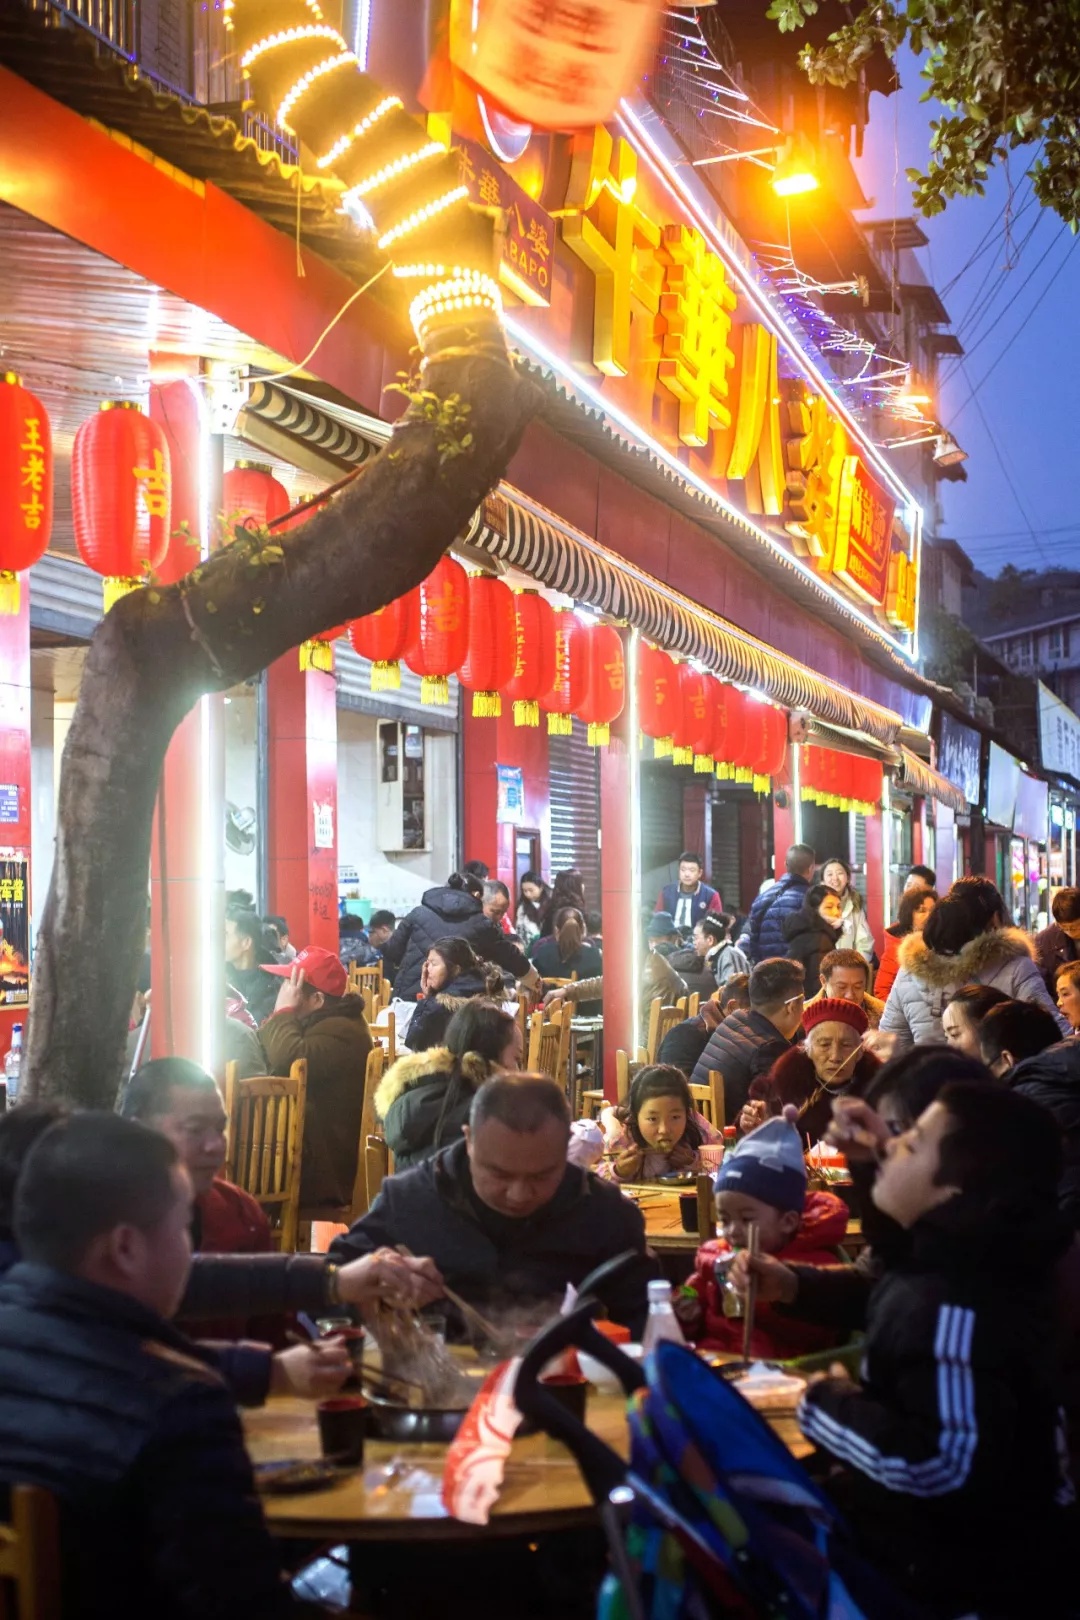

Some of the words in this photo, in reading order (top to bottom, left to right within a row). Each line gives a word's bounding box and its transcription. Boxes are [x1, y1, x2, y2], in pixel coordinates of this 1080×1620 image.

[20, 418, 46, 529] 王老吉
[132, 448, 170, 518] 吉
[427, 580, 463, 632] 吉
